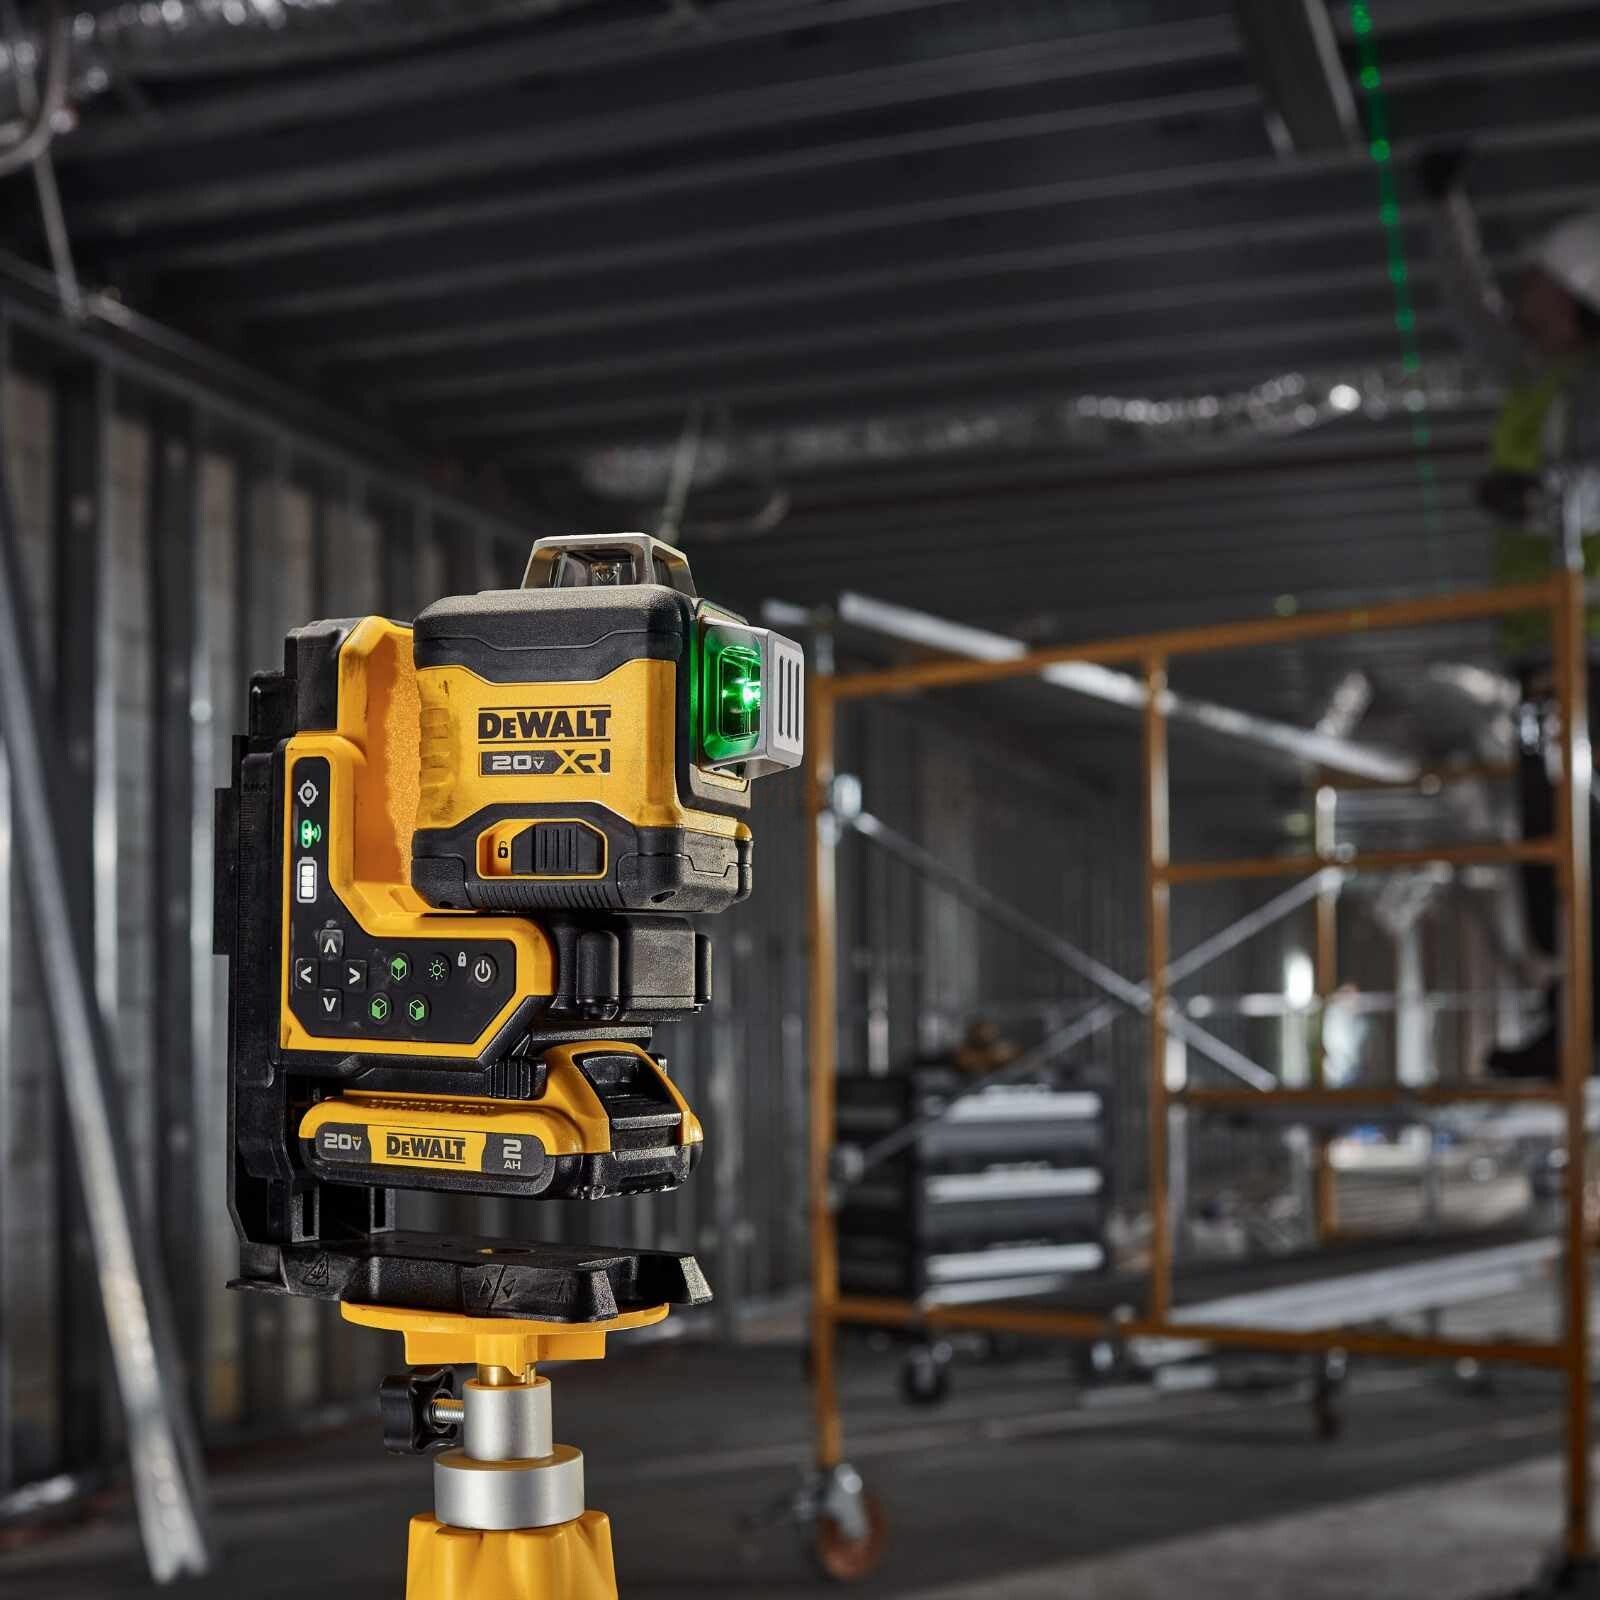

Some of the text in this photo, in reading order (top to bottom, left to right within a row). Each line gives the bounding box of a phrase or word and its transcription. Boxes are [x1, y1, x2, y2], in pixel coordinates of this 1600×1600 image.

[553, 749, 605, 775] XR
[503, 1138, 522, 1160] 2
[503, 1159, 521, 1170] AH
